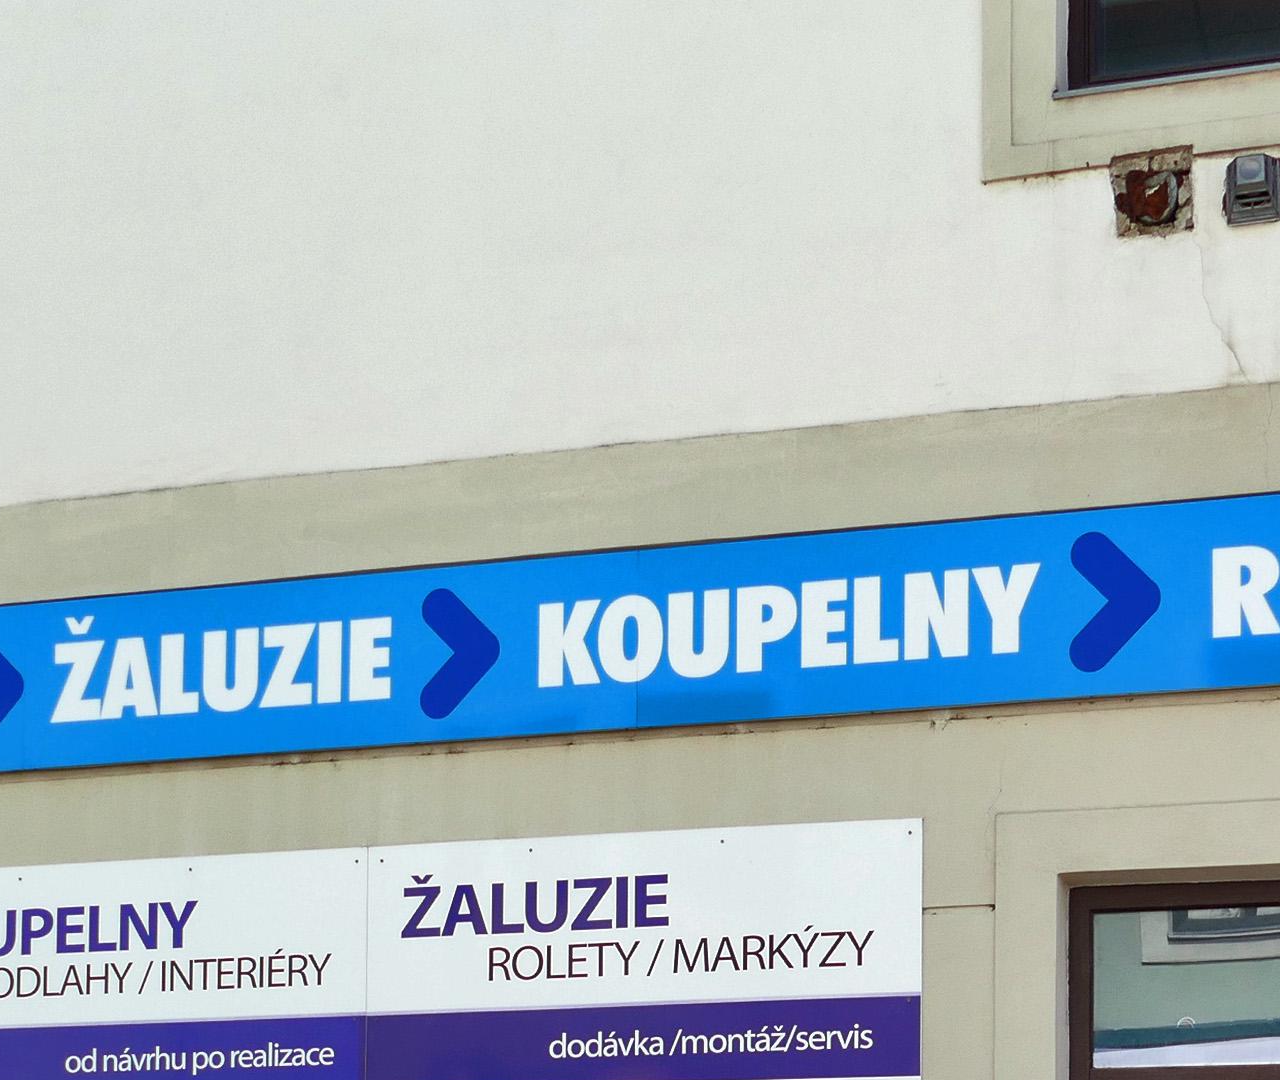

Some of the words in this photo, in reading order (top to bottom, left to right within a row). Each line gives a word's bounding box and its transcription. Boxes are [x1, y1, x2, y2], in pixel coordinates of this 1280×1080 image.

[51, 615, 393, 725] ŽALUZIE
[538, 562, 1041, 688] KOUPELNY
[401, 874, 669, 939] ŽALUZIE
[138, 965, 153, 995] /
[161, 949, 332, 992] INTERIÉRY
[488, 941, 639, 981] ROLETY
[647, 938, 664, 977] /
[673, 925, 875, 974] MARKÝZY
[65, 1047, 97, 1074] od
[103, 1045, 186, 1072] návrhu
[192, 1050, 226, 1076] po
[230, 1042, 335, 1069] realizace
[548, 1030, 664, 1060] dodávka
[669, 1023, 874, 1057] /montáž/servis
